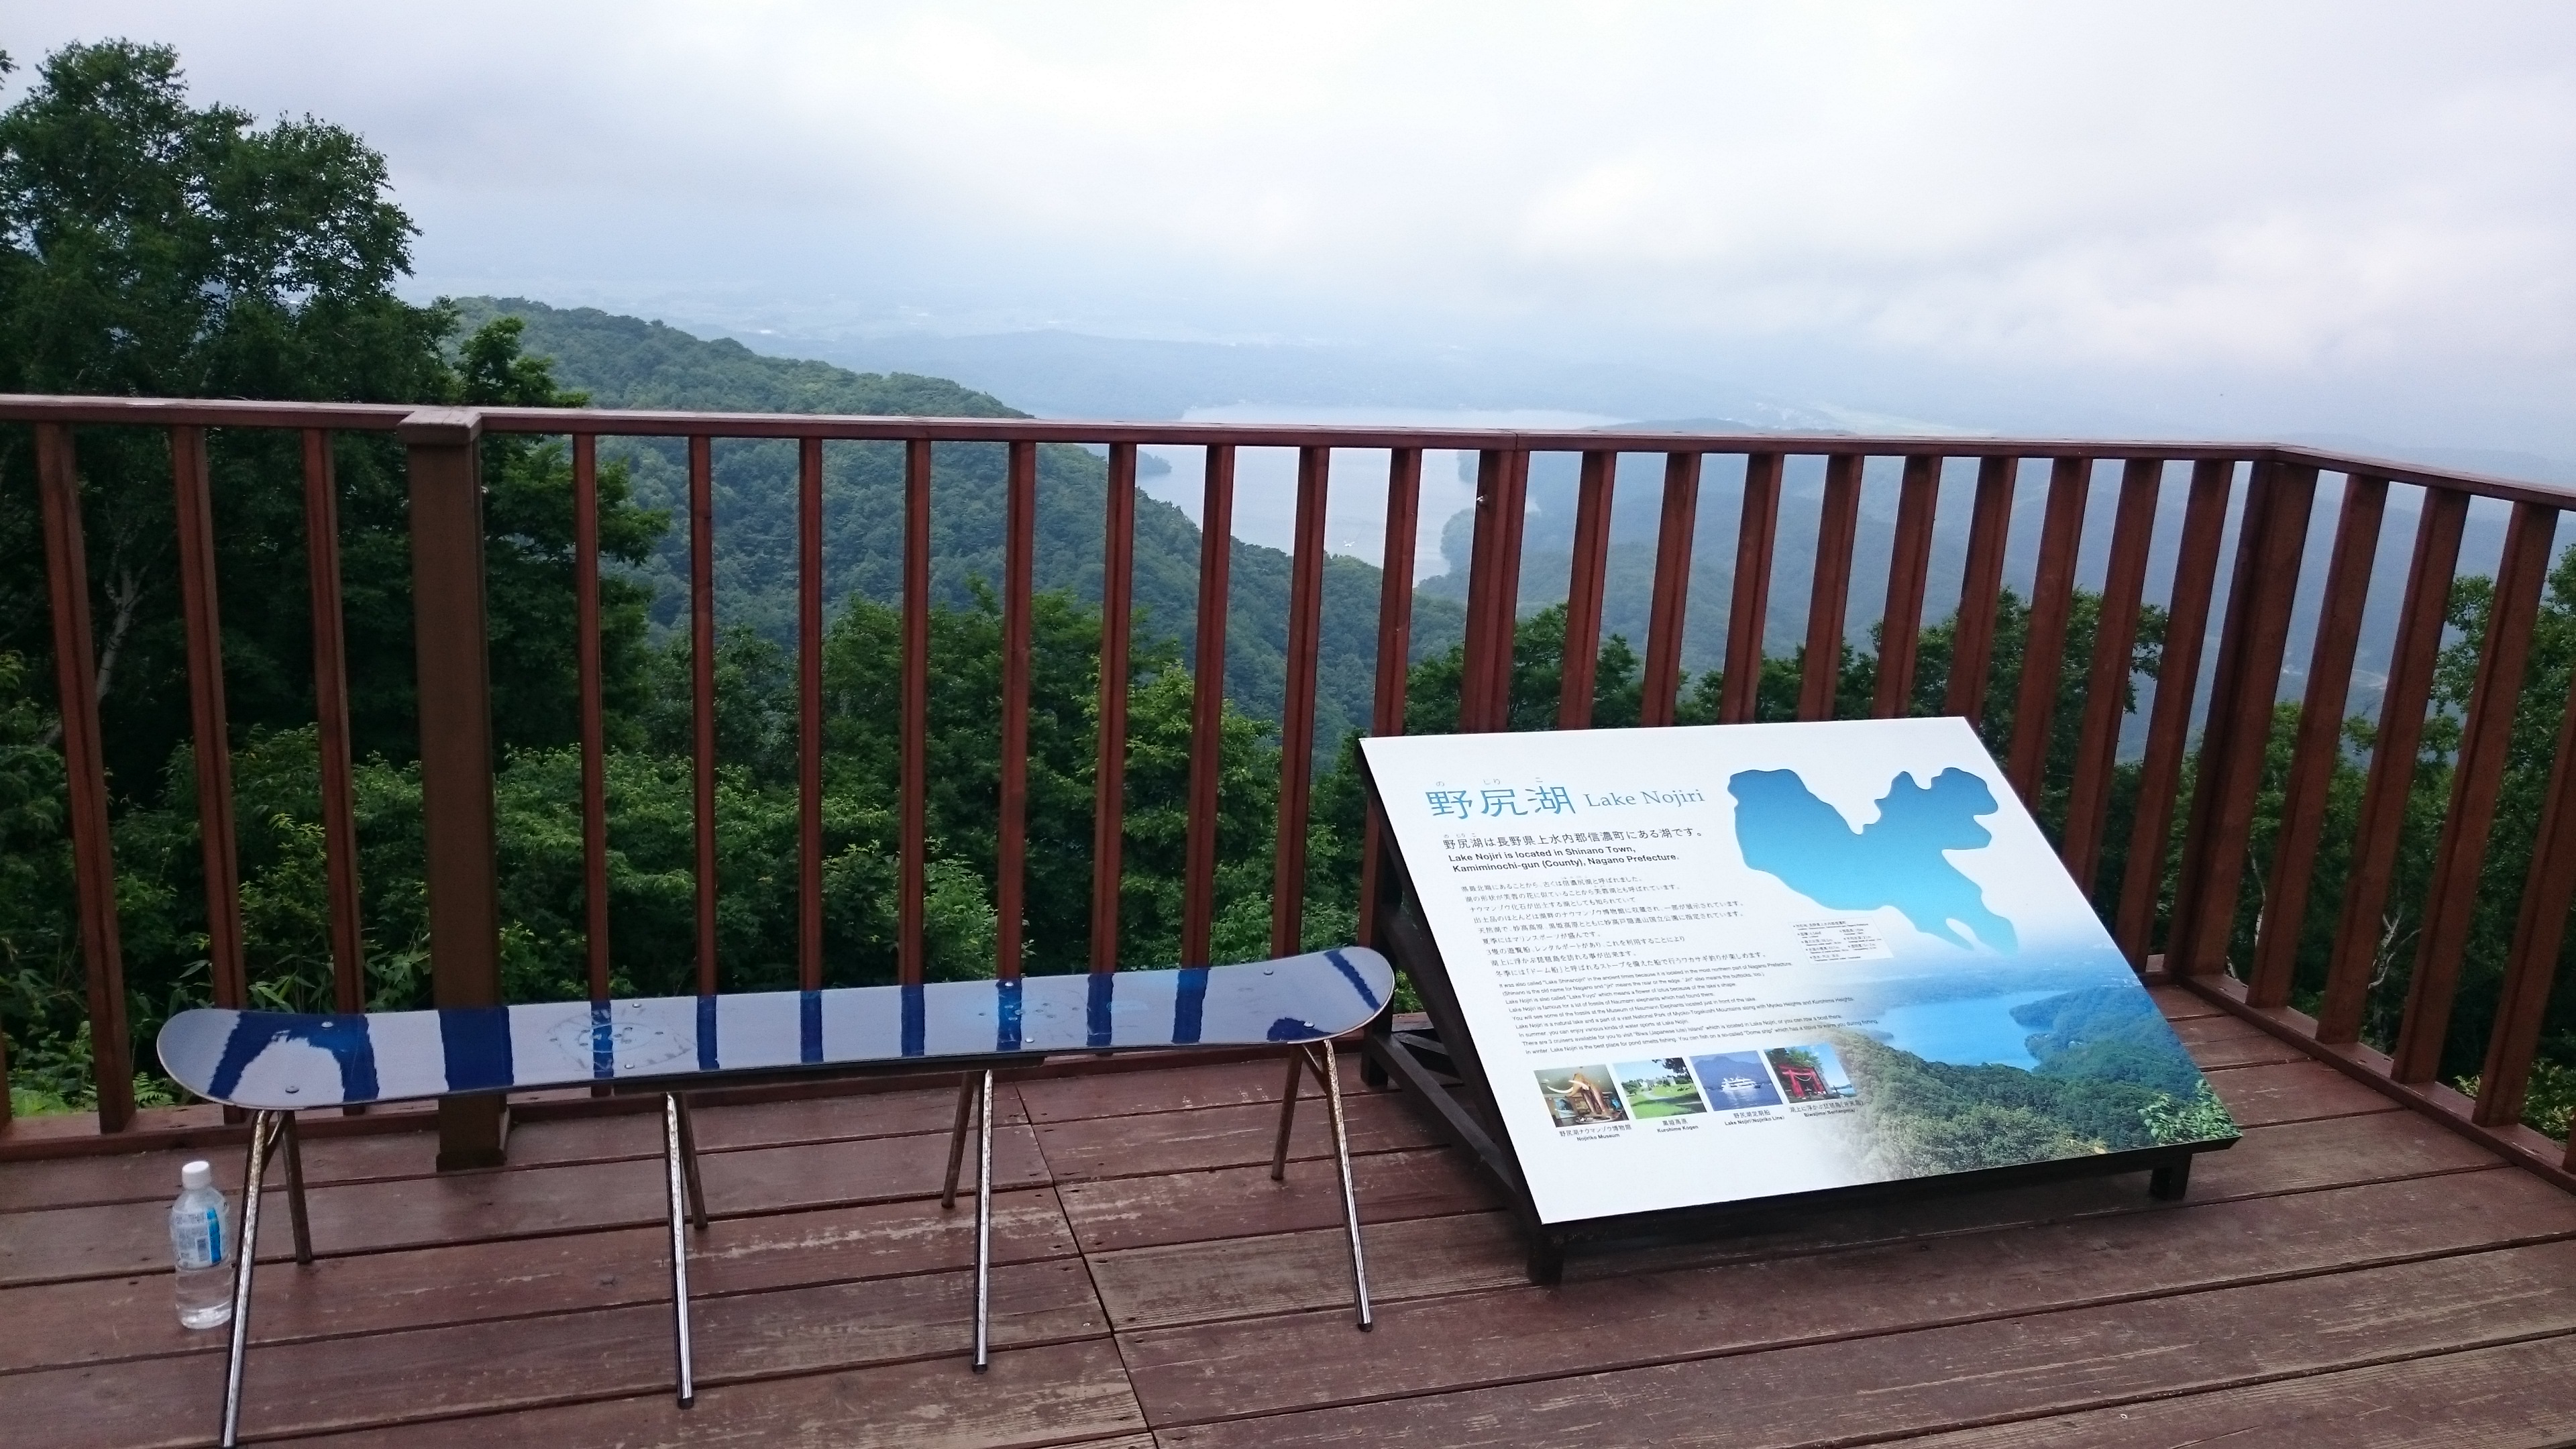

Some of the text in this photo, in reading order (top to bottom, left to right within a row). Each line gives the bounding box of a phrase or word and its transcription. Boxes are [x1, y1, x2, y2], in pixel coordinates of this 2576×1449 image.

[1425, 786, 1576, 819] 野尻湖
[1582, 788, 1705, 807] Lake Nojiri
[1442, 827, 1701, 849] 野尻湖は長野県上水内郡信濃町にある湖です。
[1447, 845, 1636, 861] Lake Nojiri is located in Shinano Town,
[1451, 853, 1679, 872] Kamiminochi-gun (County), Nagano Prefecture.
